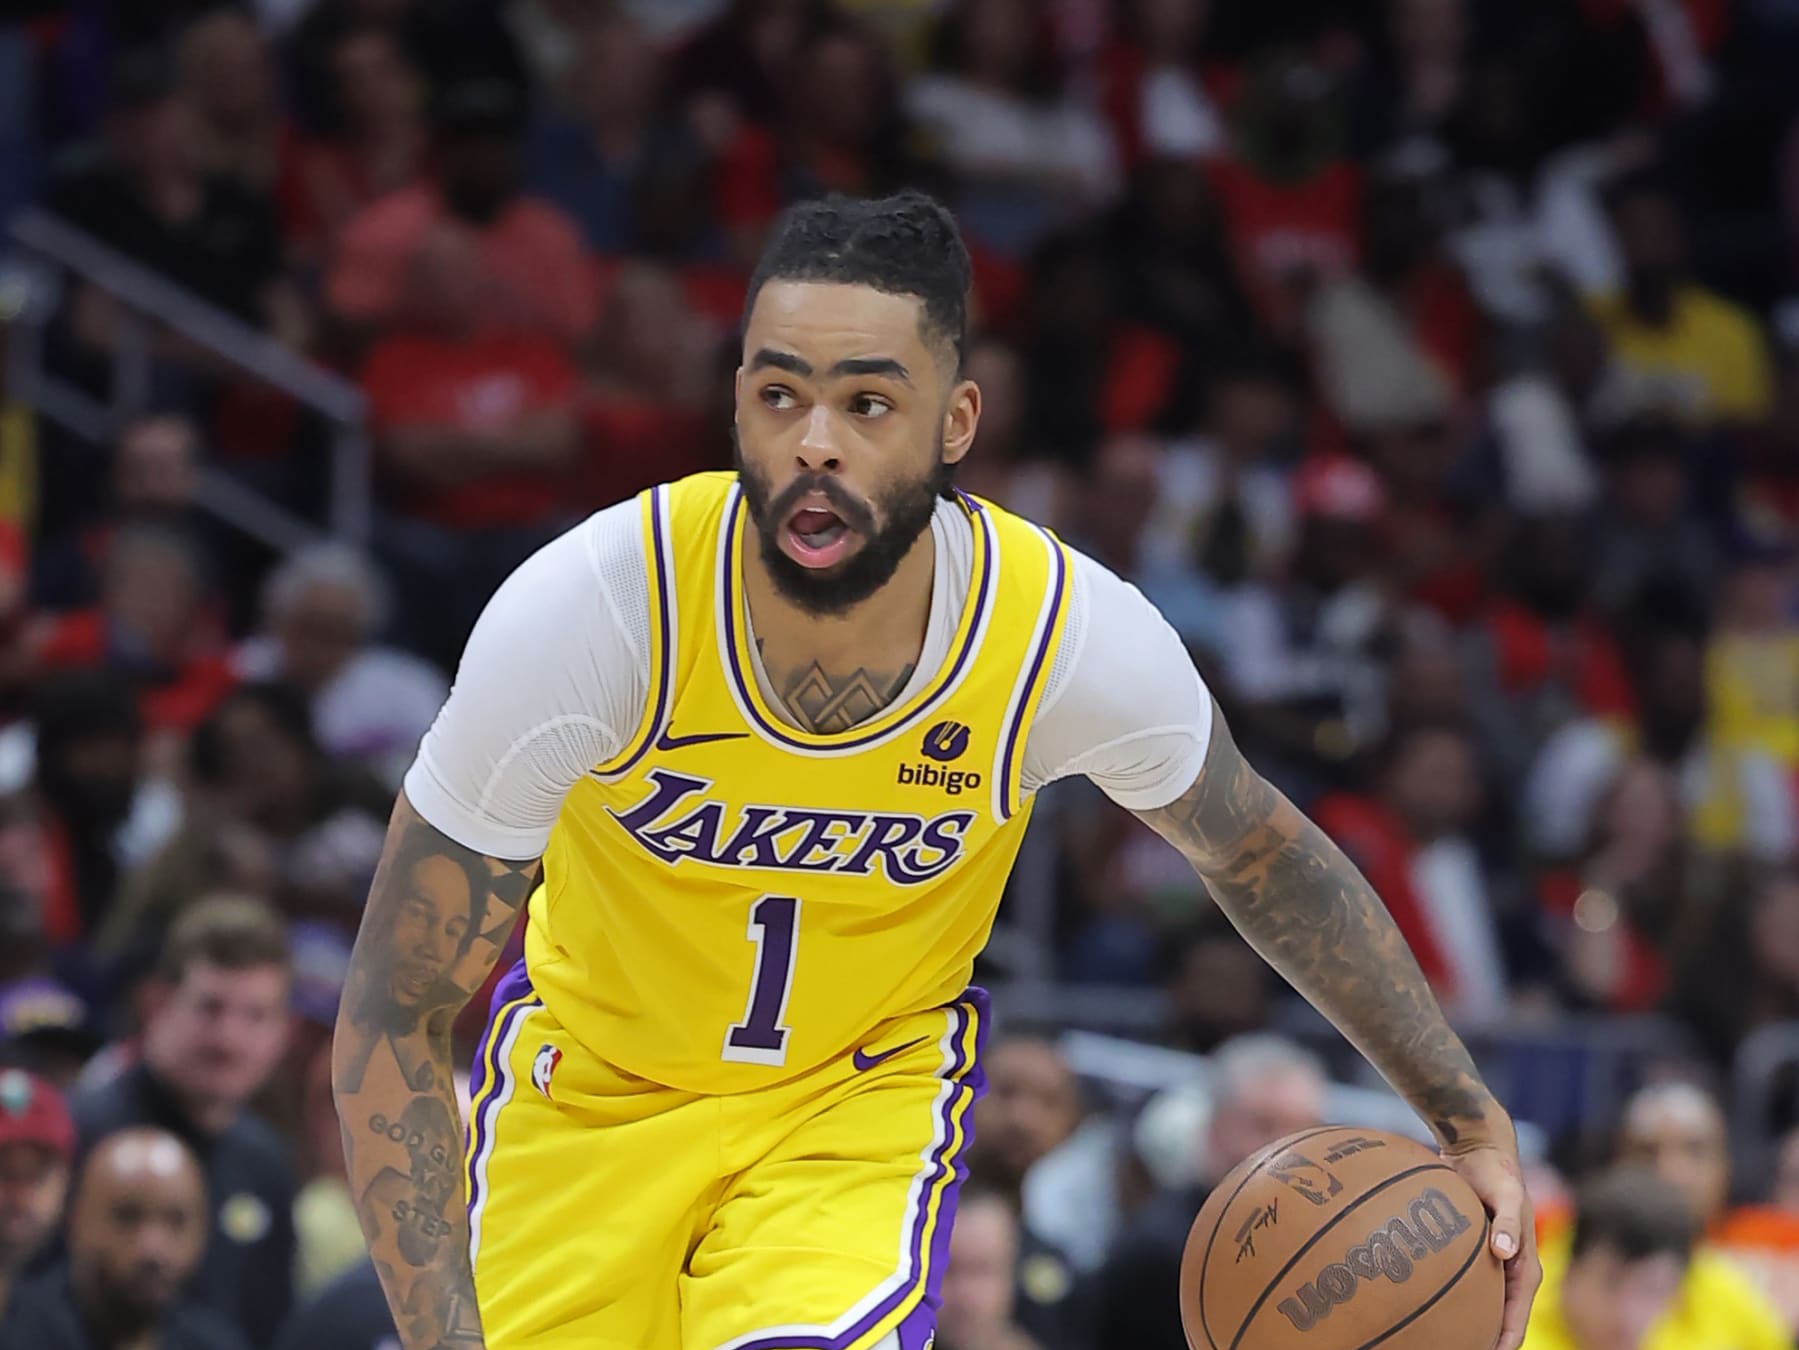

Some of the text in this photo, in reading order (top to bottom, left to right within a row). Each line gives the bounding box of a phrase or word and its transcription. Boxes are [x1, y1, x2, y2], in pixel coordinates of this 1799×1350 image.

[603, 767, 978, 886] LAKERS
[897, 763, 981, 795] bibigo
[721, 893, 802, 1066] 1
[369, 1114, 424, 1149] GOD
[1278, 1187, 1471, 1332] Wilson
